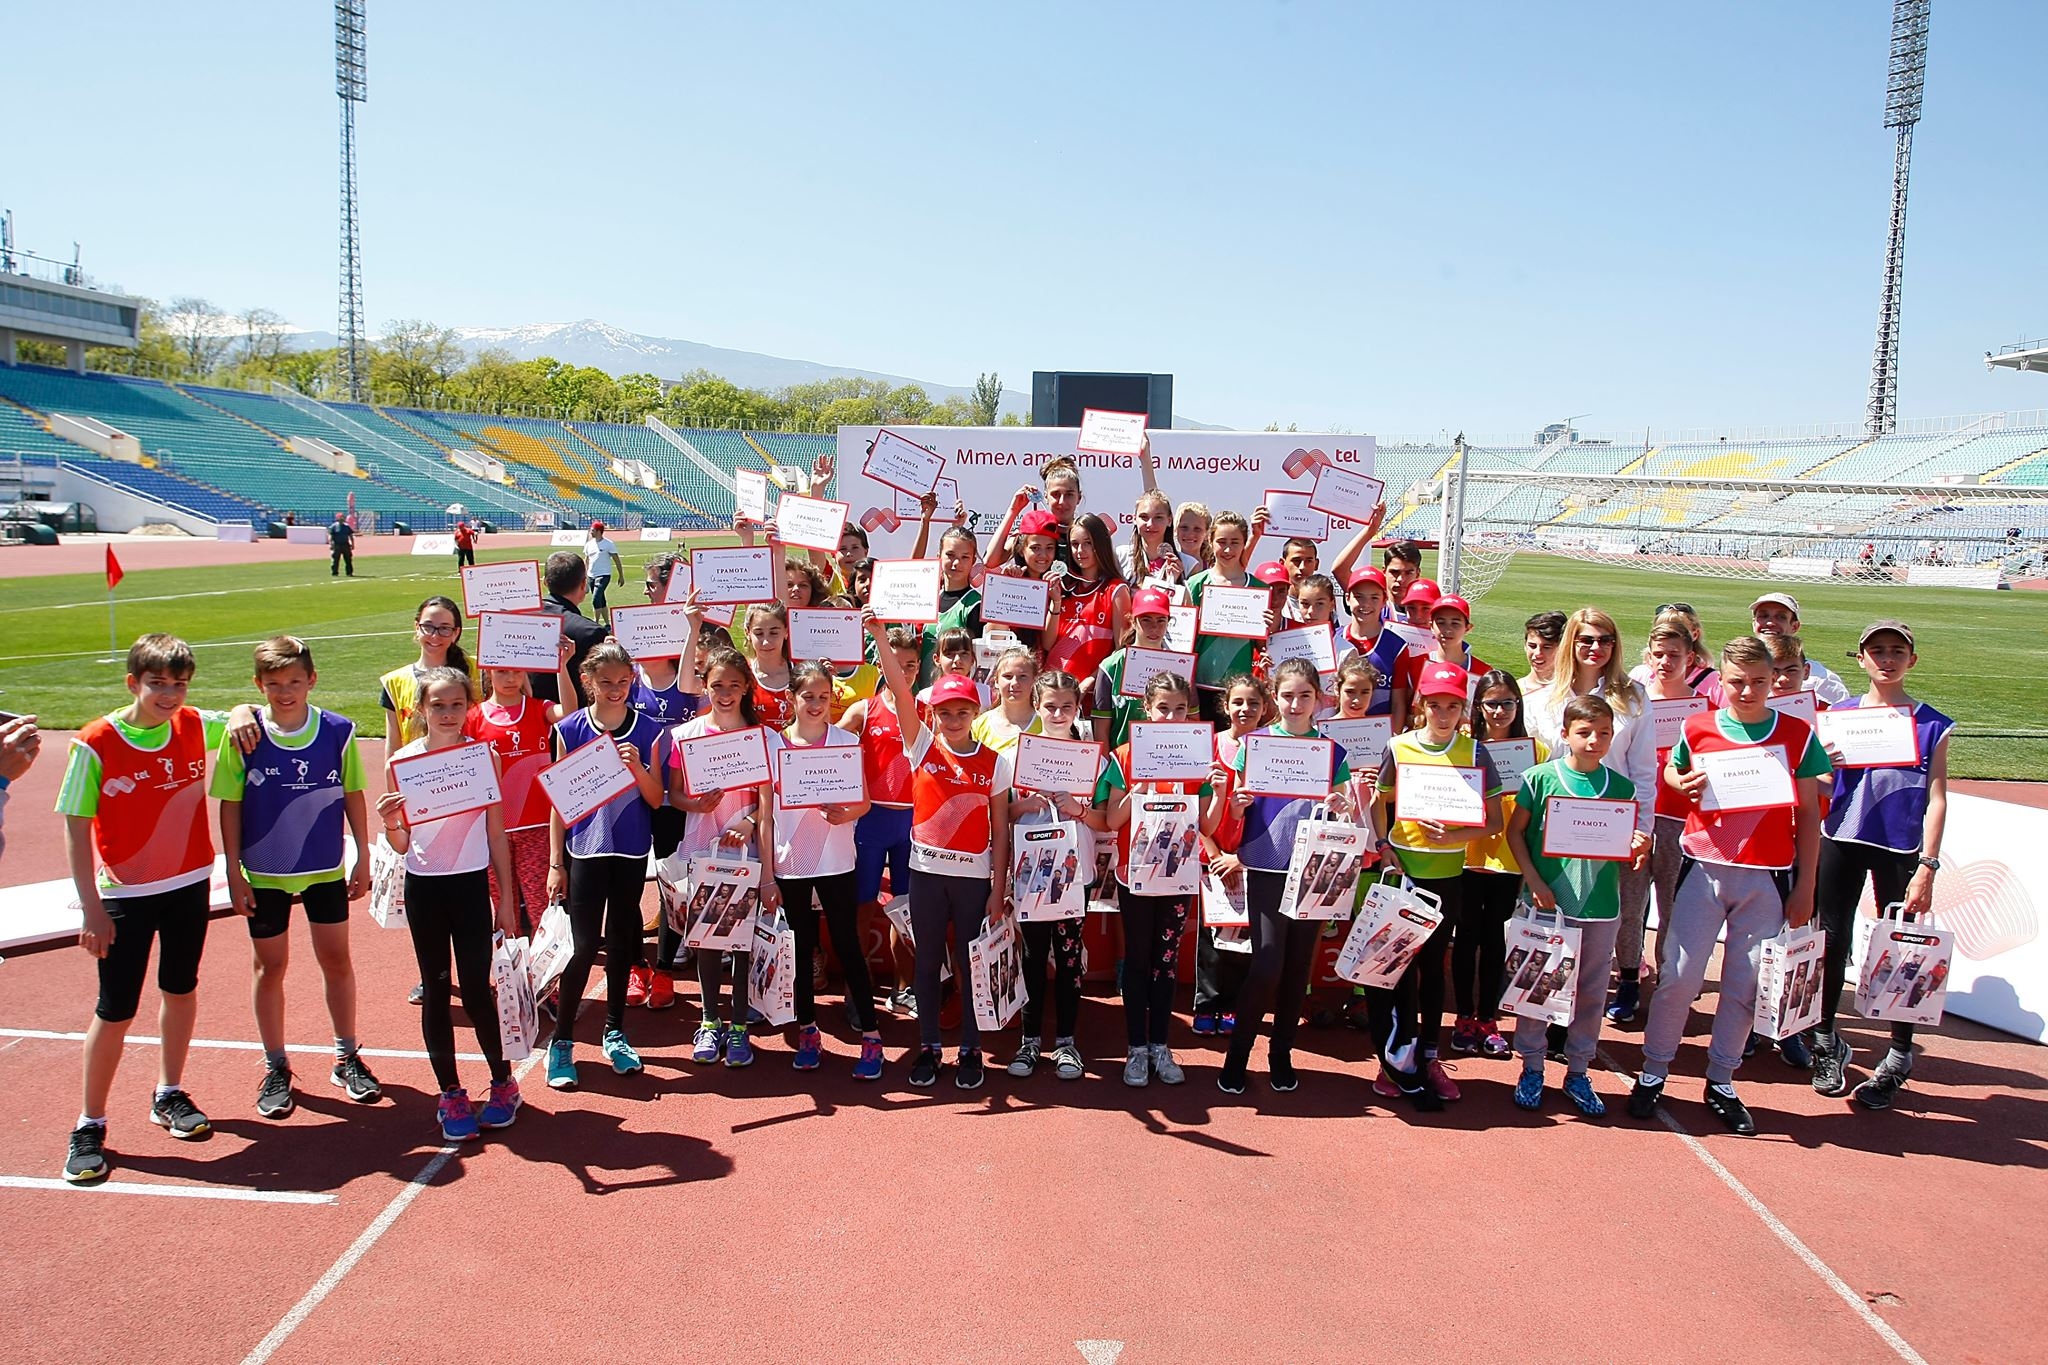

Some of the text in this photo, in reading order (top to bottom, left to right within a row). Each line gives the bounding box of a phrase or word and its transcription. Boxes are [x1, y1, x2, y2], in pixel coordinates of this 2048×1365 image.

[1335, 448, 1360, 463] tel
[892, 453, 920, 469] ГРАМОТА
[1168, 453, 1260, 473] младежи
[1330, 518, 1351, 530] tel
[486, 580, 516, 588] ГРАМОТА
[1001, 592, 1026, 601] ГРАМОТА
[1097, 611, 1106, 625] 9
[635, 623, 667, 631] ГРАМОТА
[1284, 641, 1312, 654] ГРАМОТА
[1654, 716, 1686, 724] ГРАМОТА
[1846, 728, 1884, 736] ГРАМОТА
[708, 751, 740, 762] ГРАМОТА
[1271, 757, 1304, 765] ГРАМОТА
[1040, 757, 1074, 767] ГРАМОТА
[134, 769, 150, 781] tel
[265, 767, 281, 776] tel
[569, 763, 599, 786] ГРАМОТА
[1723, 769, 1760, 778] ГРАМОТА
[972, 773, 992, 788] 134
[429, 780, 468, 794] ГРАМОТА
[1572, 819, 1608, 828] ГРАМОТА
[1032, 831, 1053, 840] SPORT
[1326, 834, 1347, 842] SPORT
[1407, 913, 1426, 924] SPORT
[1530, 932, 1549, 941] SPORT
[866, 929, 883, 963] 2
